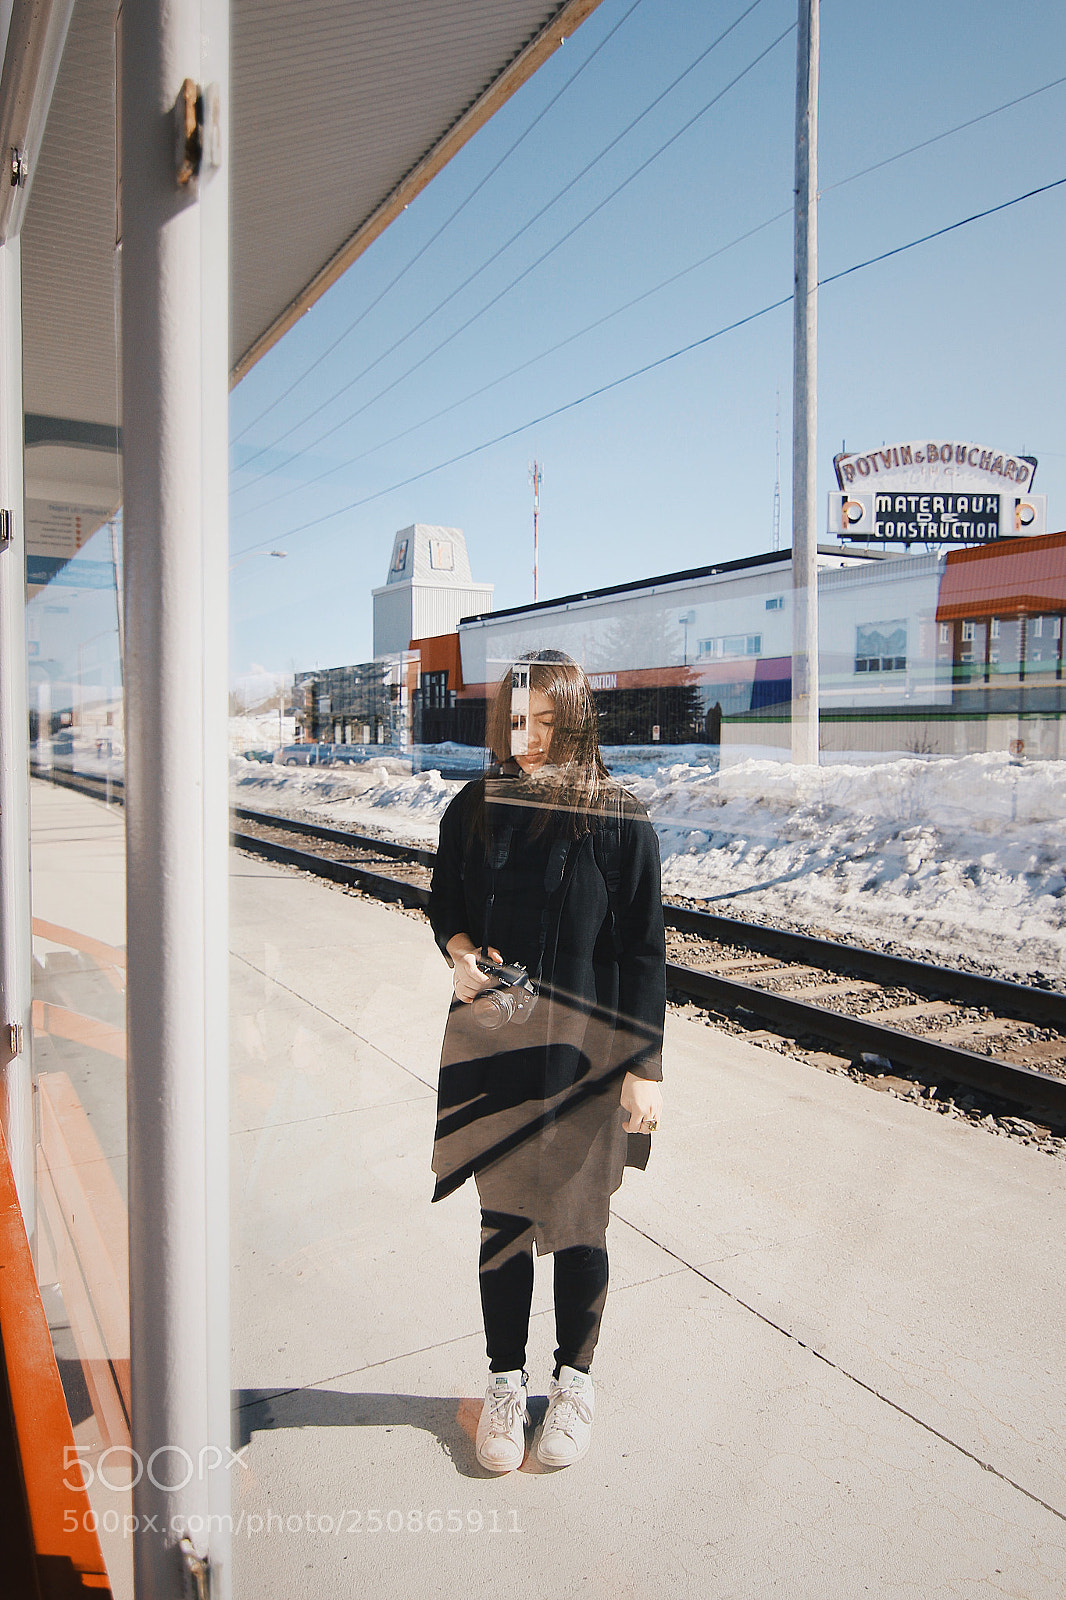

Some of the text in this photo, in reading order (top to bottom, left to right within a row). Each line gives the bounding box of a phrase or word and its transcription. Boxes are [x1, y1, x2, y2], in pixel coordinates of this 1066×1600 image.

[927, 443, 1029, 484] BOUCHARD
[875, 495, 998, 514] MATERIAUX
[916, 512, 960, 523] DE
[874, 521, 998, 539] CONSTRUCTION
